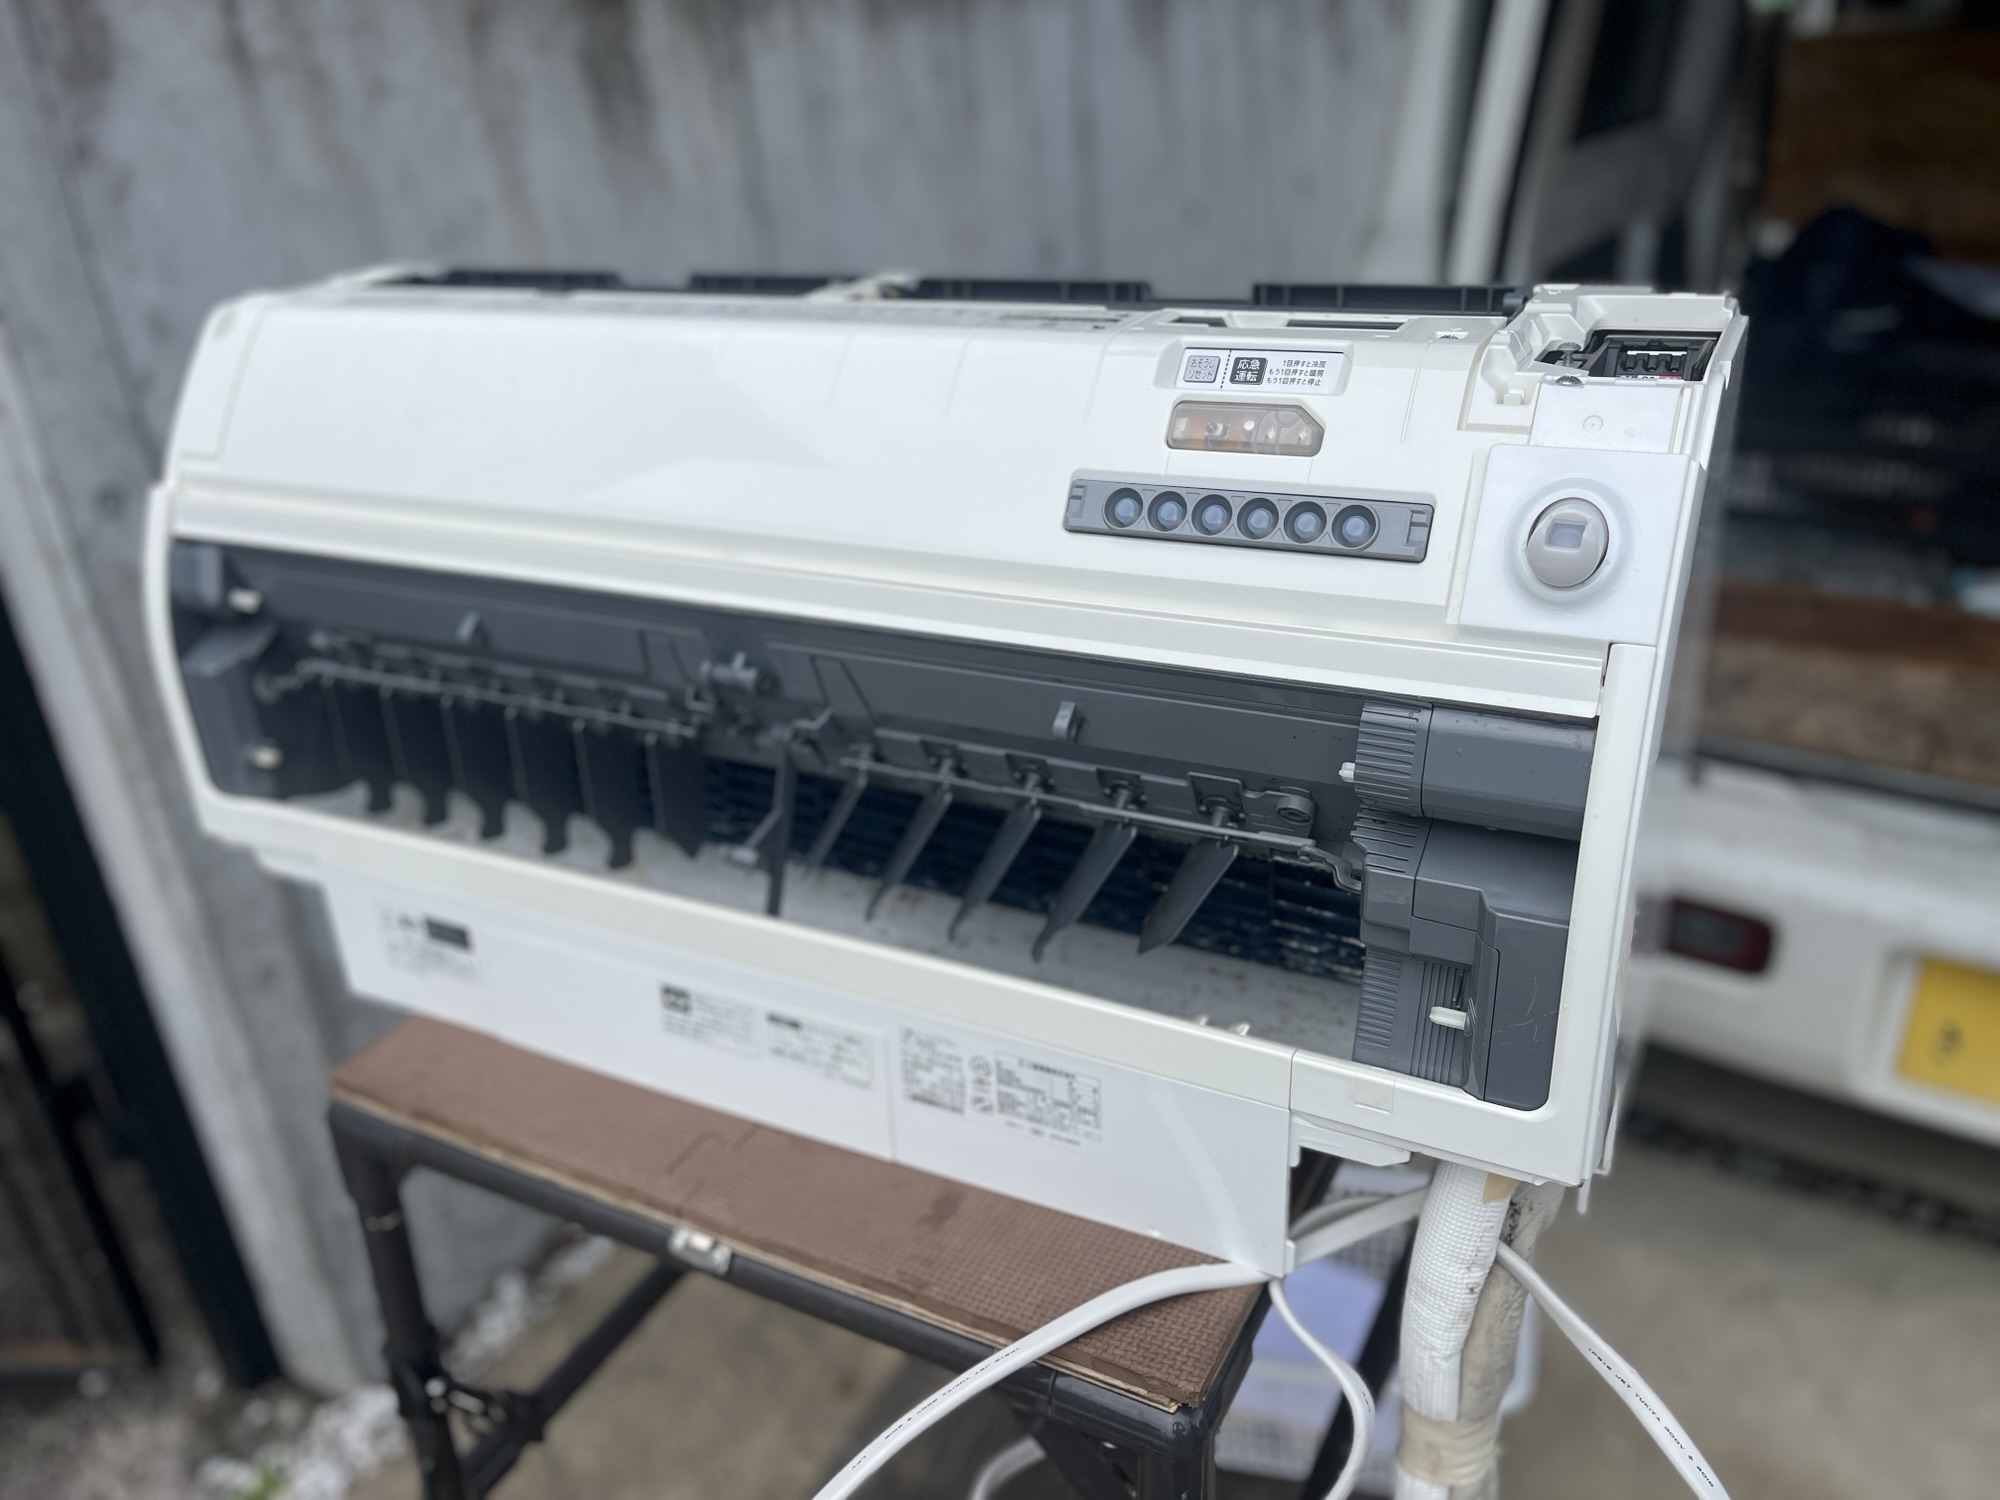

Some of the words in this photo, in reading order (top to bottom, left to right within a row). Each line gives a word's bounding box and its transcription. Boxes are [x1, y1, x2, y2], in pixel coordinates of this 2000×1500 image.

[1236, 359, 1260, 370] 応急
[1283, 359, 1327, 369] 1回押すと冷房
[1188, 370, 1213, 380] リセット
[1234, 371, 1259, 382] 運転
[1269, 368, 1325, 378] もう1回押すと暖房
[1267, 377, 1322, 387] もう1回押すと停止
[1615, 1374, 1632, 1389] JET
[1635, 1392, 1661, 1422] YUKITA
[1664, 1425, 1685, 1450] 300V
